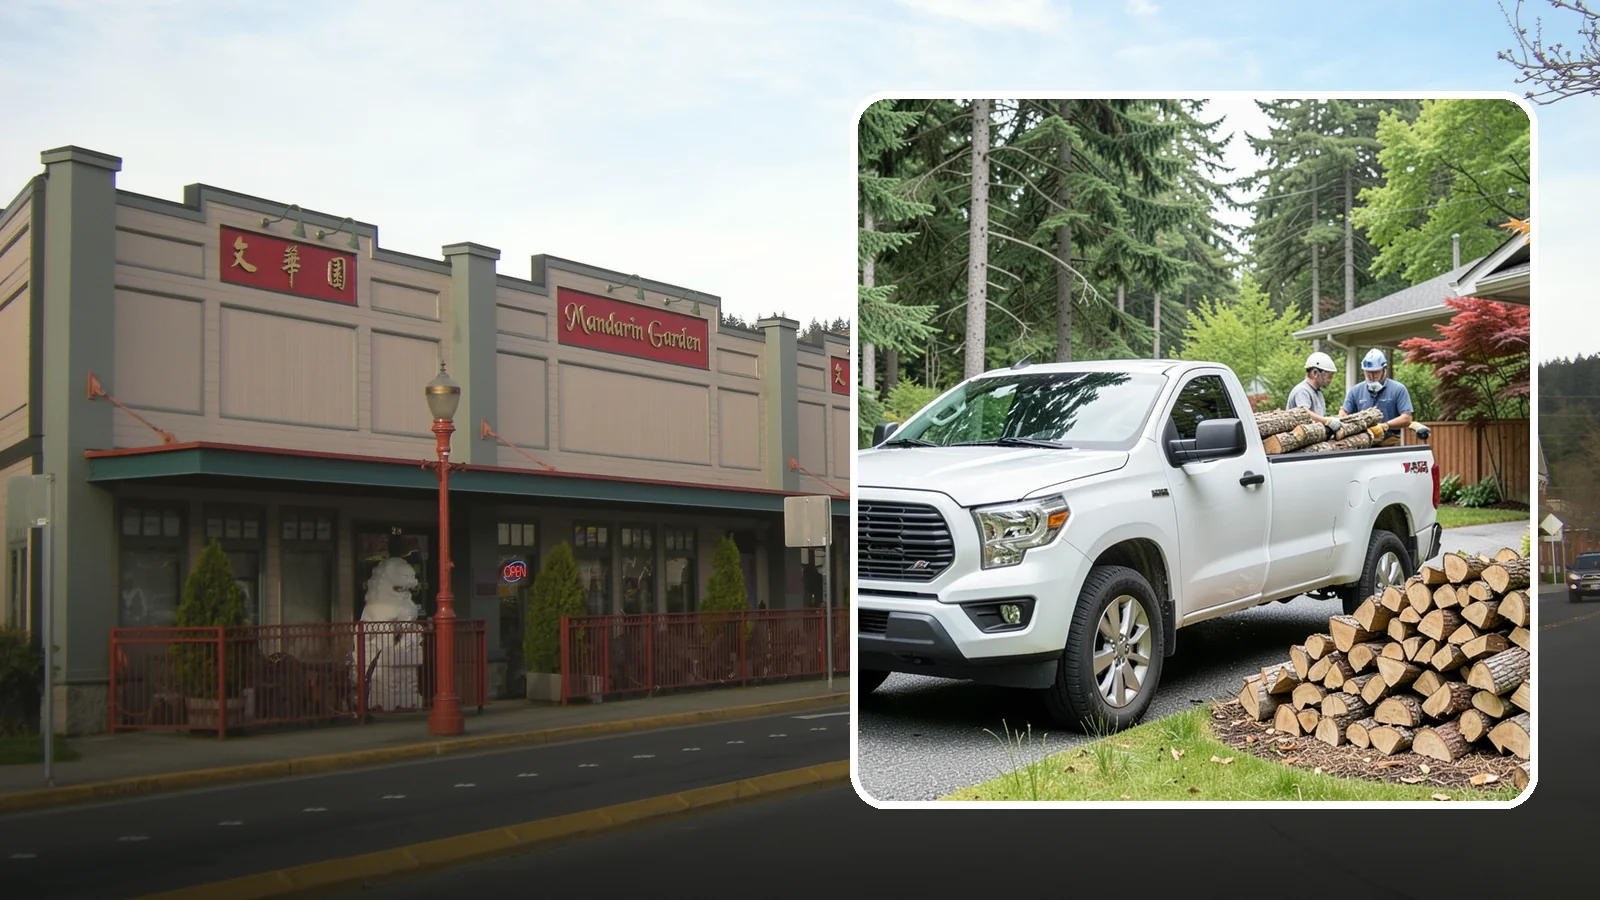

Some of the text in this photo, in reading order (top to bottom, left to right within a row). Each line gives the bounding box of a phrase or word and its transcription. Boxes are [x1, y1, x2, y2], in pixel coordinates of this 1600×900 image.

[230, 235, 346, 291] 文華園
[564, 302, 702, 352] Mandarin Garden
[834, 363, 846, 386] 文
[503, 565, 528, 578] OPEN
